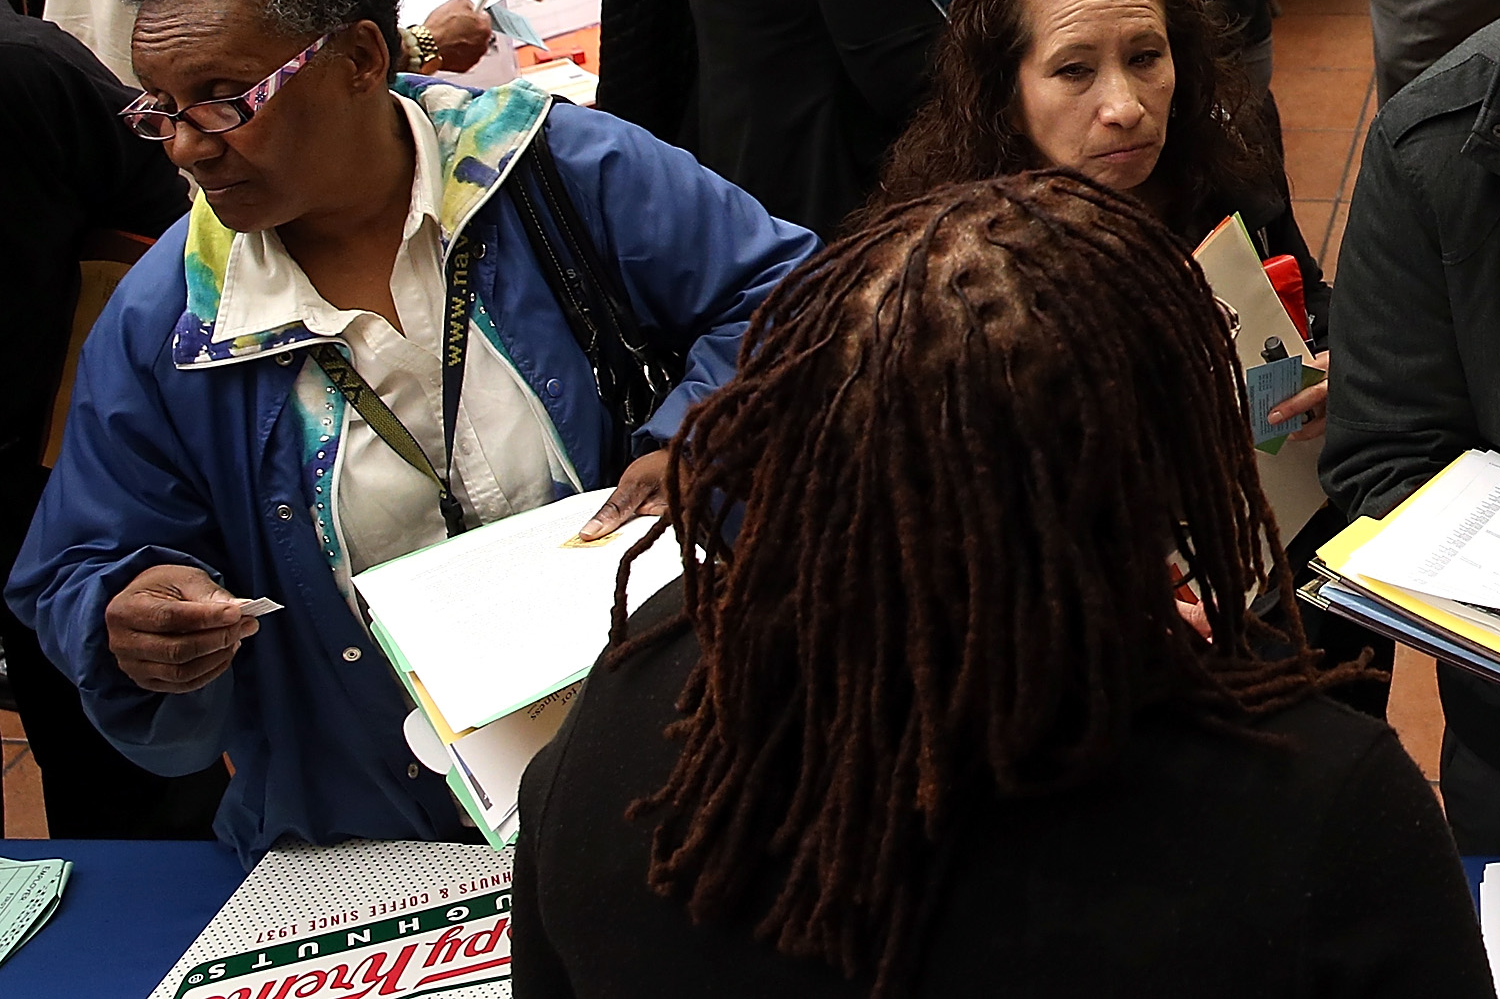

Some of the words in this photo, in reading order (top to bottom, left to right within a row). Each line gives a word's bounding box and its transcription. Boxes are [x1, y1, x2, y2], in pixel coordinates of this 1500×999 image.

[448, 223, 471, 367] www.nav
[530, 692, 560, 720] llness
[439, 887, 450, 899] &
[459, 871, 512, 895] HNUTS
[368, 892, 429, 917] COFFEE
[308, 910, 359, 932] SINCE
[208, 893, 512, 980] UGHNUTS
[256, 924, 298, 944] 1937
[422, 916, 512, 969] py
